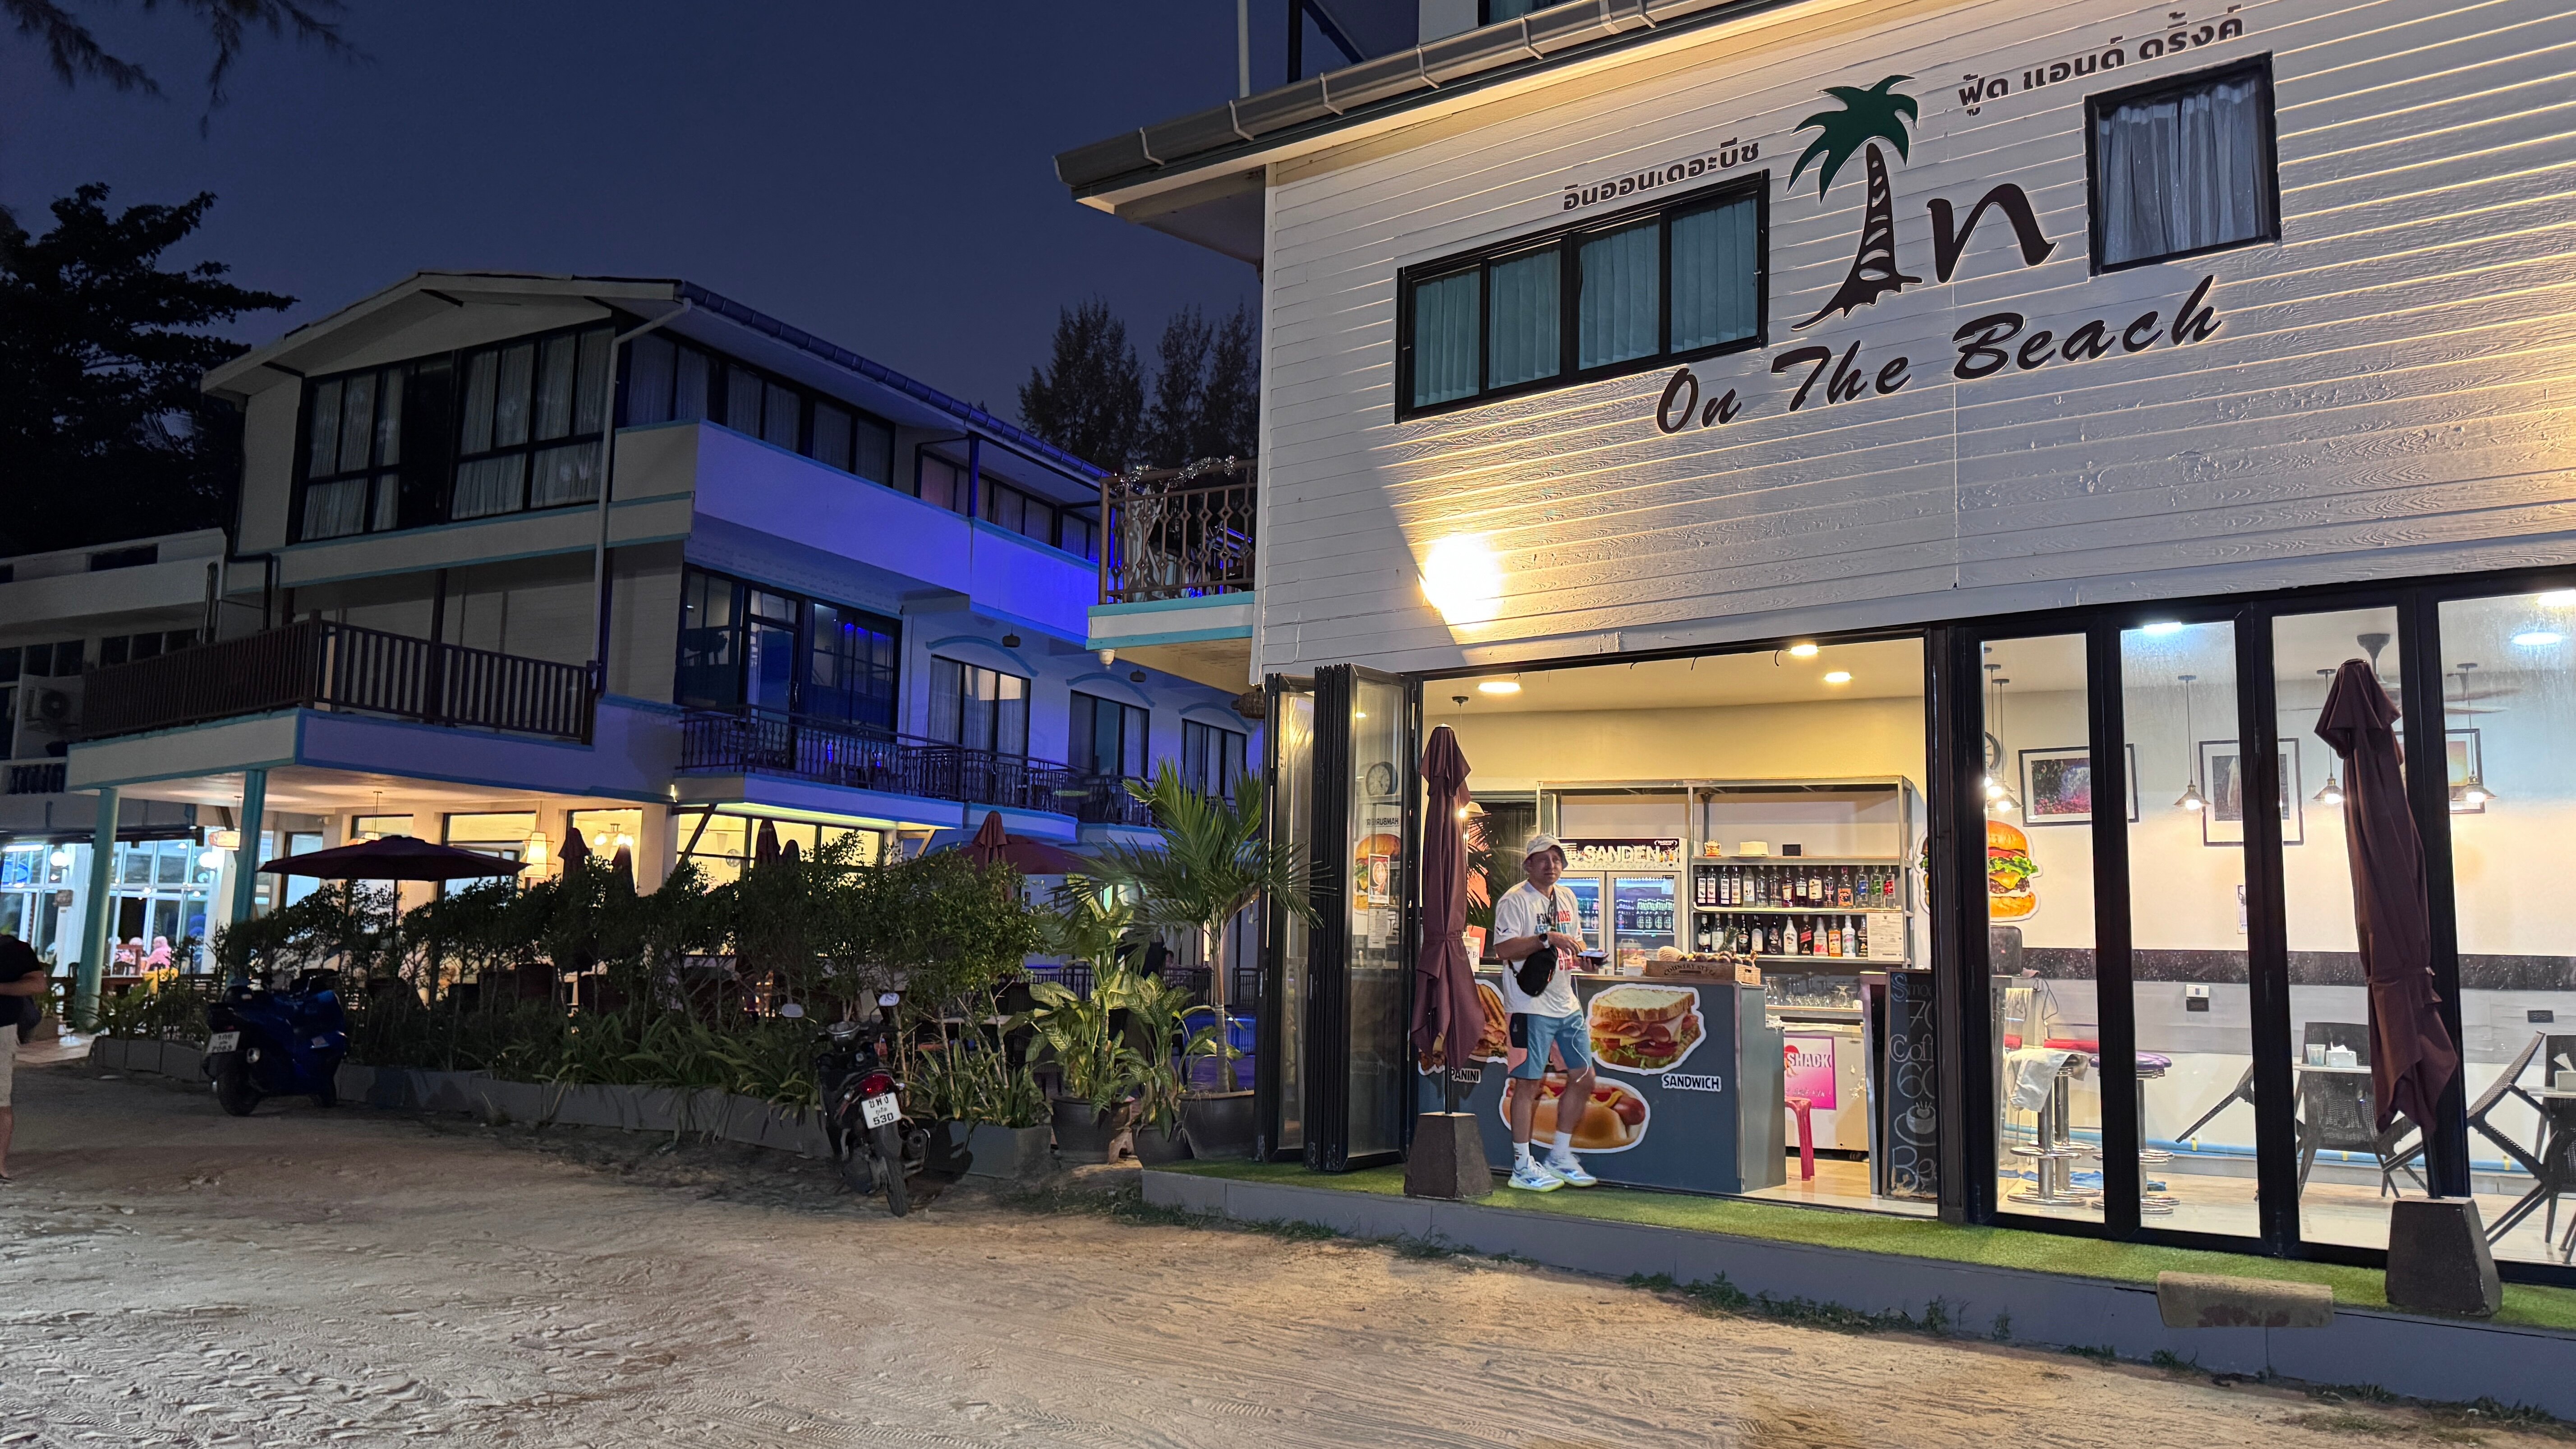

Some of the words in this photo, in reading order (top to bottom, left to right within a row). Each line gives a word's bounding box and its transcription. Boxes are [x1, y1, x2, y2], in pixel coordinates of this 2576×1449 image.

[1959, 74, 2008, 116] ฟู้ด
[2024, 35, 2125, 90] แอนด์
[2139, 4, 2243, 60] ดริ้งค์
[1564, 137, 1758, 211] อินออนเดอะบีช
[1656, 367, 1742, 434] On
[1772, 340, 1911, 412] The
[1953, 275, 2223, 380] Beach
[1583, 845, 1660, 862] SANDEN
[1787, 1053, 1831, 1068] SHACK
[1451, 1068, 1479, 1081] PANINI
[1663, 1075, 1719, 1090] SANDWICH
[873, 1112, 894, 1125] 530
